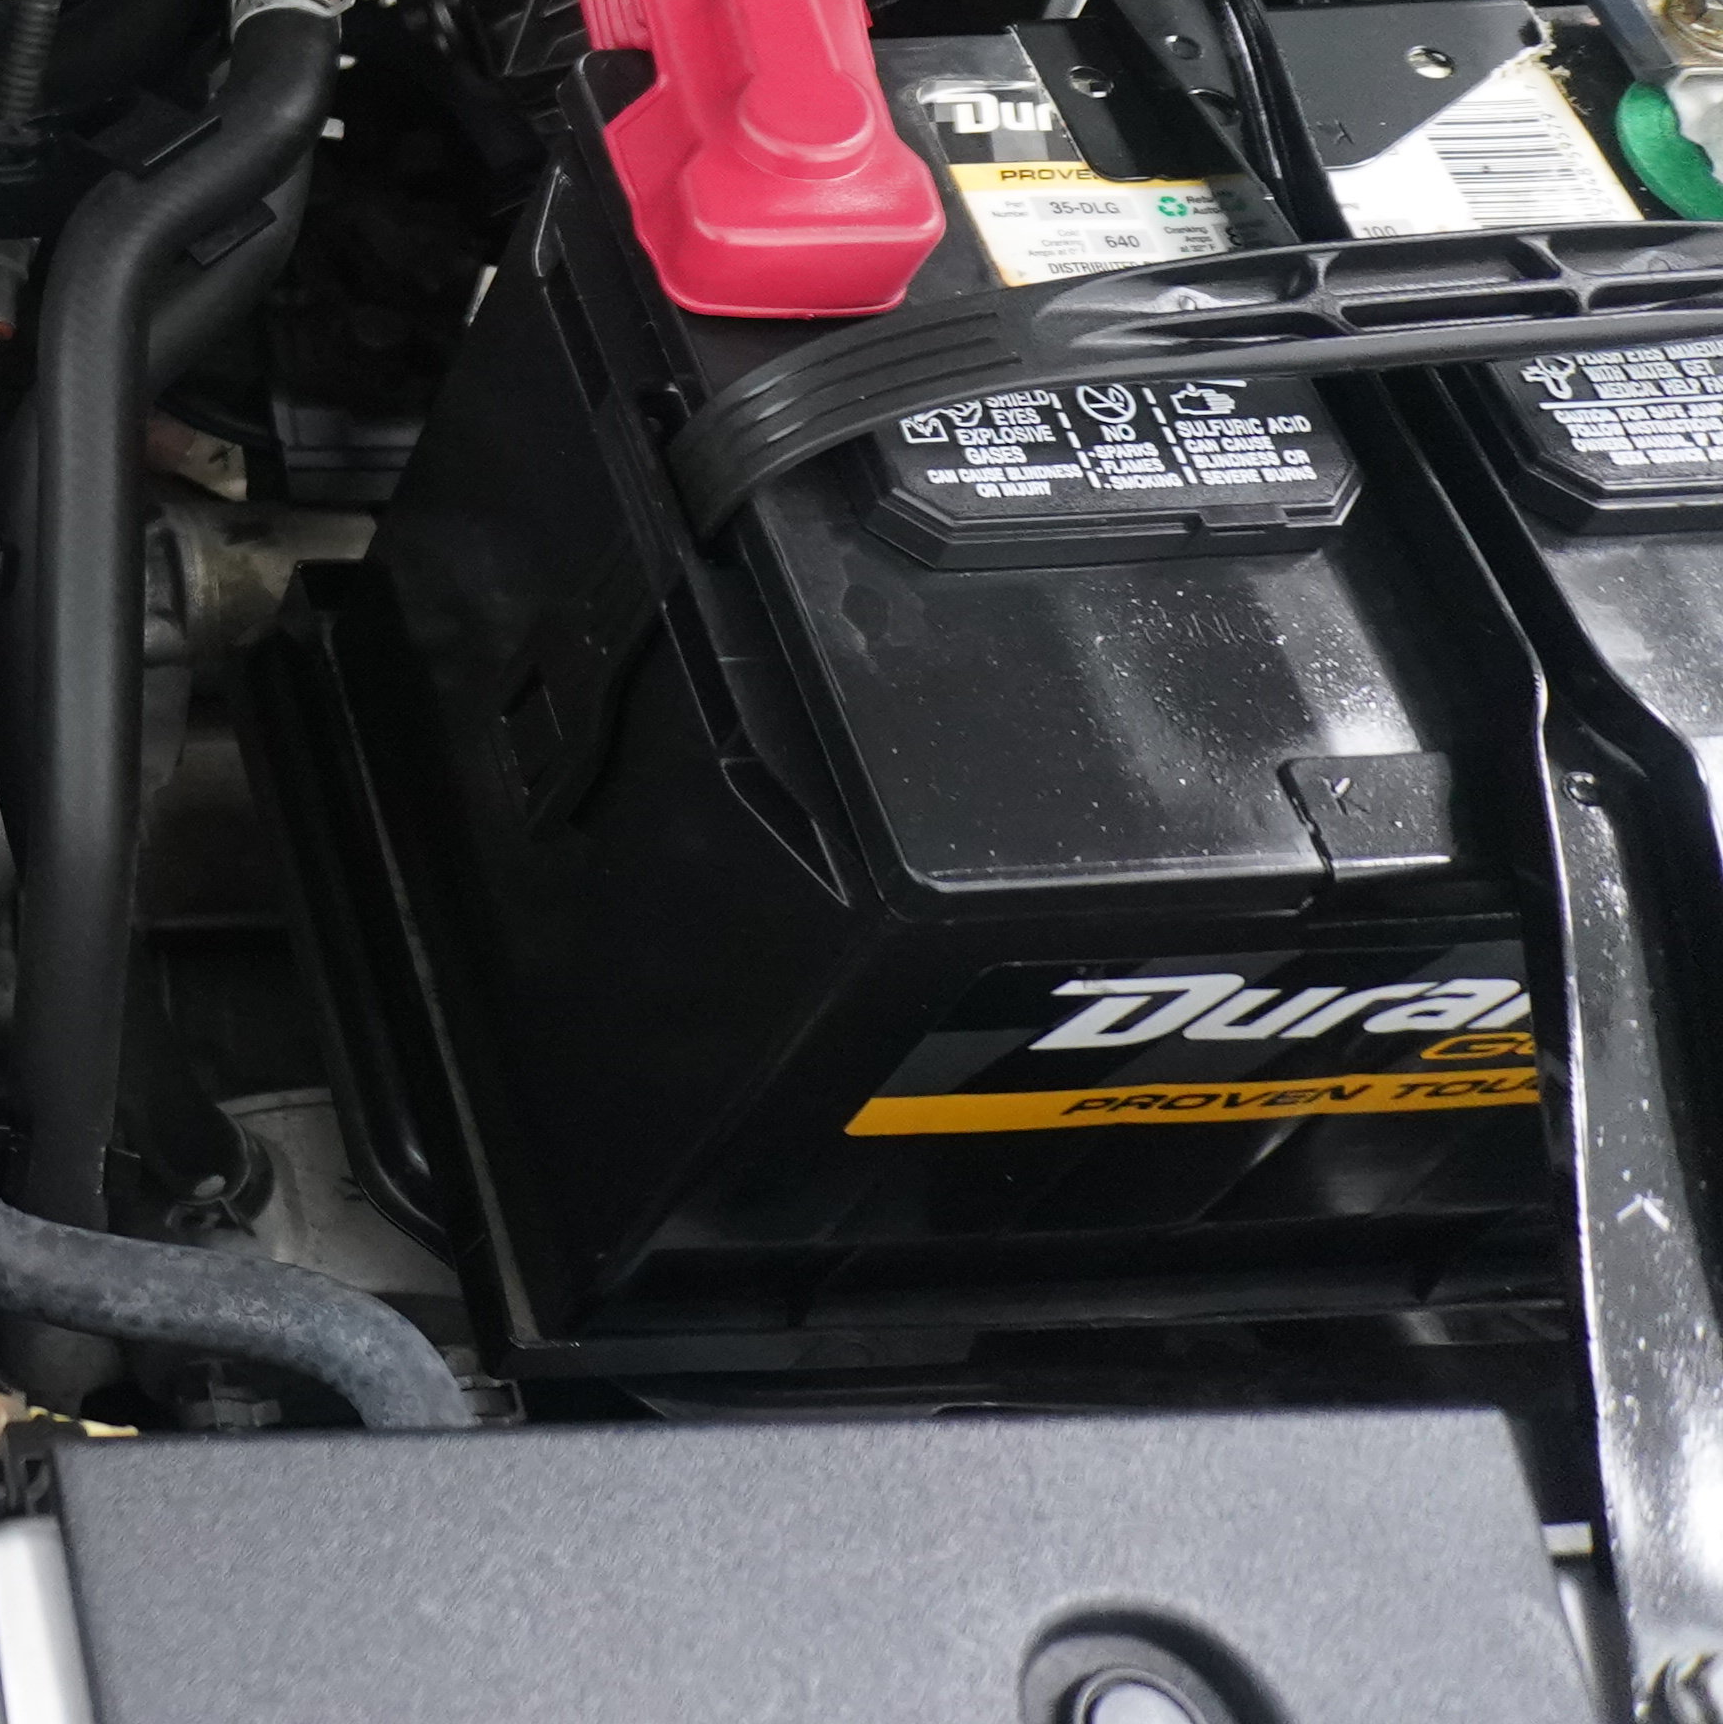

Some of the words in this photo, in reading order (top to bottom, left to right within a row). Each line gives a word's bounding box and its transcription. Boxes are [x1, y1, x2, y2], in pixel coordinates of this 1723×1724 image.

[1000, 169, 1100, 180] PROVE
[1048, 201, 1121, 214] 35-DLG
[1104, 234, 1140, 249] 640
[1581, 365, 1628, 383] WITH
[1679, 358, 1715, 377] GET
[1592, 380, 1664, 400] MEDICAL
[1658, 377, 1702, 397] HELP
[983, 389, 1051, 408] SHIELD
[990, 407, 1042, 426] EYES
[1614, 405, 1651, 421] FOR
[1645, 403, 1688, 419] SAFE
[954, 424, 1056, 445] EXPLOSIVE
[1099, 424, 1136, 441] NO
[1174, 417, 1264, 438] SULFURIC
[1267, 415, 1312, 435] ACID
[1566, 421, 1627, 438] FOLLOW
[1183, 438, 1221, 454] CAN
[1220, 435, 1276, 452] CAUSE
[964, 445, 1027, 465] GASES
[1190, 451, 1281, 469] BLINDNESS
[1282, 449, 1311, 465] OR
[926, 469, 959, 484] CAN
[957, 467, 1006, 482] CAUSE
[1005, 463, 1084, 481] BLINDNESS
[1198, 469, 1262, 486] SEVERE
[1260, 466, 1318, 483] BURNS
[975, 483, 1002, 498] OR
[999, 480, 1052, 497] INJURY
[1061, 1083, 1373, 1116] PROVEN
